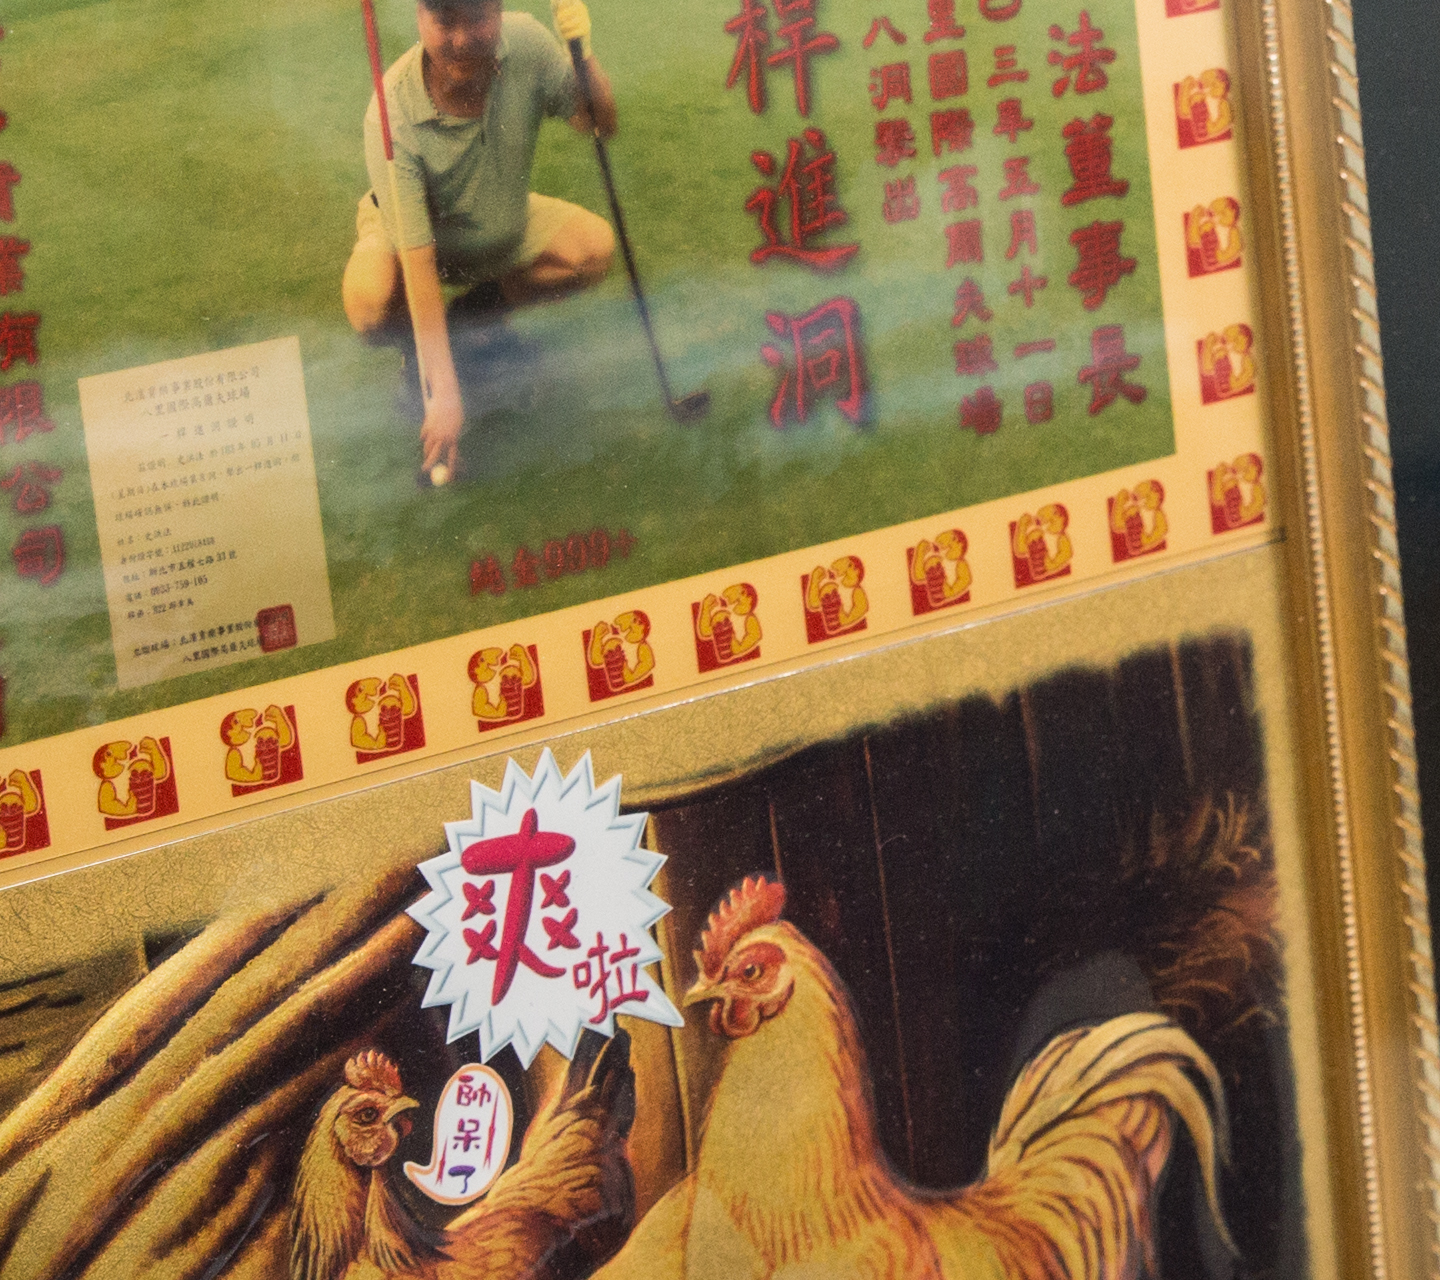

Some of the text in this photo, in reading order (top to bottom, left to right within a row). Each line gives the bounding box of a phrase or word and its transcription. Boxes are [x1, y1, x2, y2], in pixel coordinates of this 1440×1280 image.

[461, 808, 649, 1024] 爽啦
[448, 1075, 491, 1194] 帥呆了
